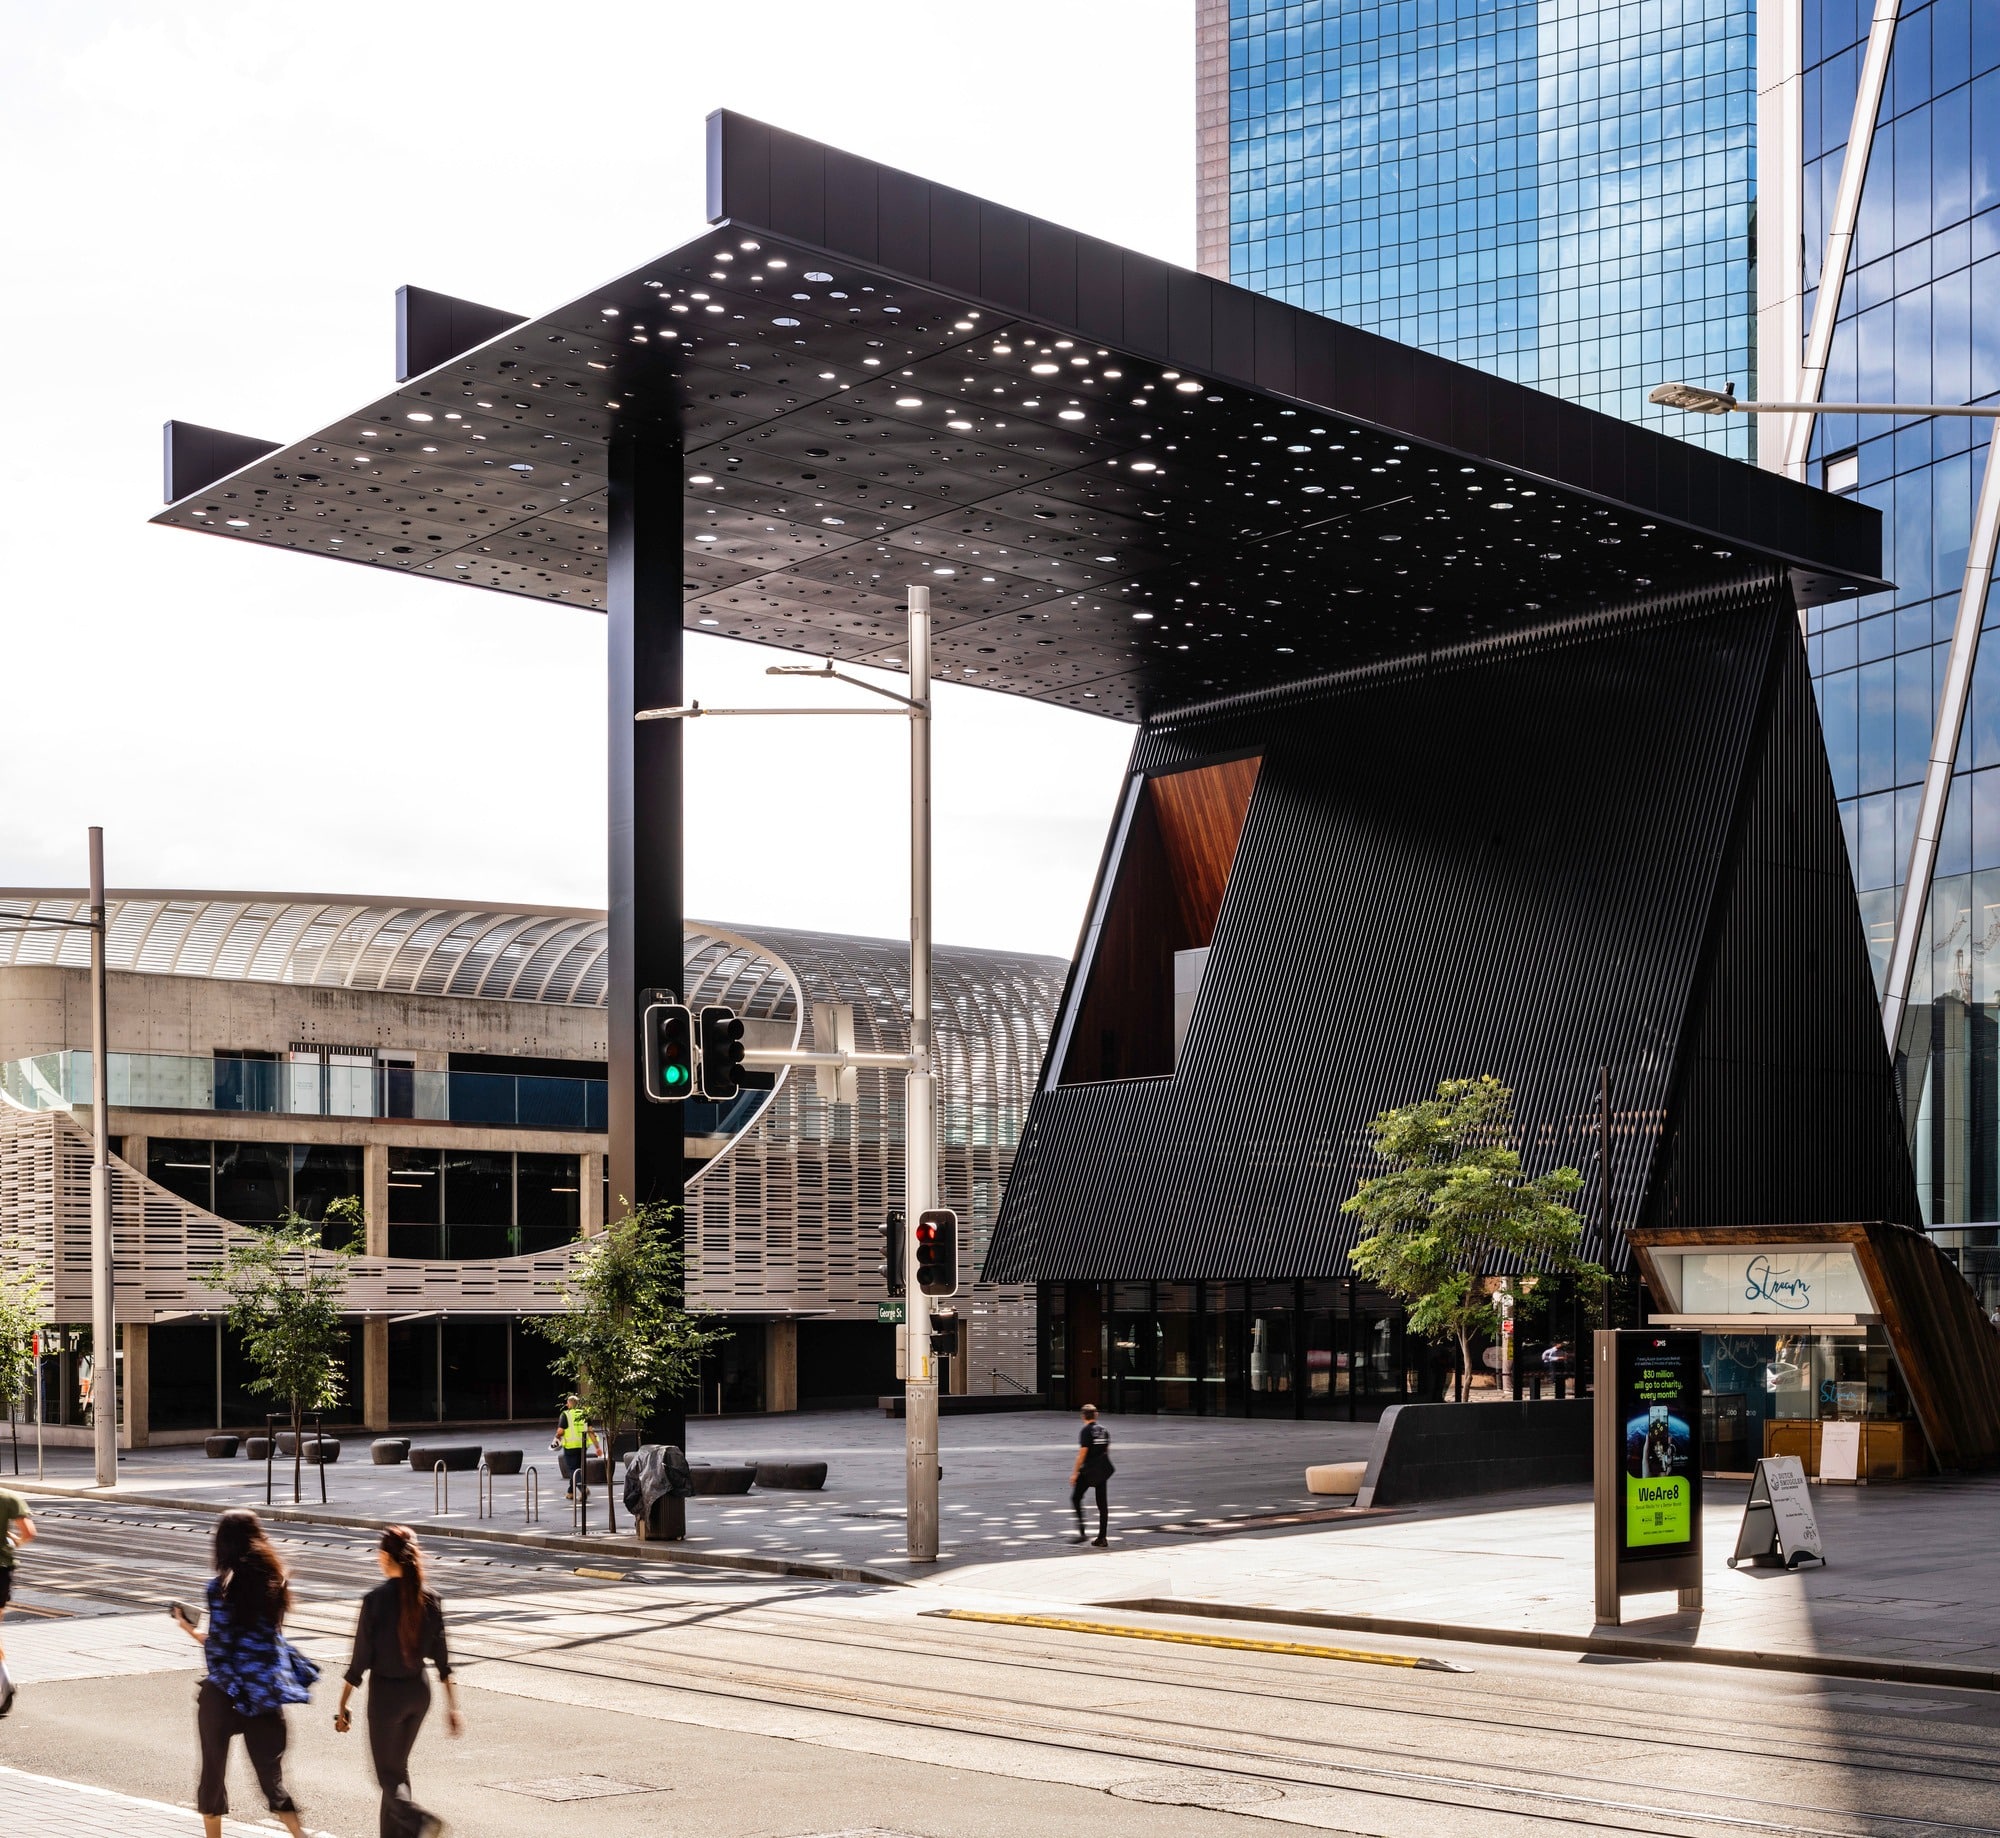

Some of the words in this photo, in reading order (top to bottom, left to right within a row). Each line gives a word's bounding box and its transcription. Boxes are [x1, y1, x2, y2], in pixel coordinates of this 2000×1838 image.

[1745, 1255, 1810, 1309] Stream
[880, 1307, 896, 1320] George
[896, 1308, 902, 1318] St
[1643, 1369, 1655, 1379] $30
[1655, 1370, 1674, 1378] million
[1634, 1381, 1645, 1389] will
[1644, 1382, 1653, 1390] go
[1653, 1381, 1661, 1389] to
[1640, 1392, 1657, 1400] every
[1656, 1390, 1678, 1398] month!
[1638, 1484, 1679, 1502] WeAre8
